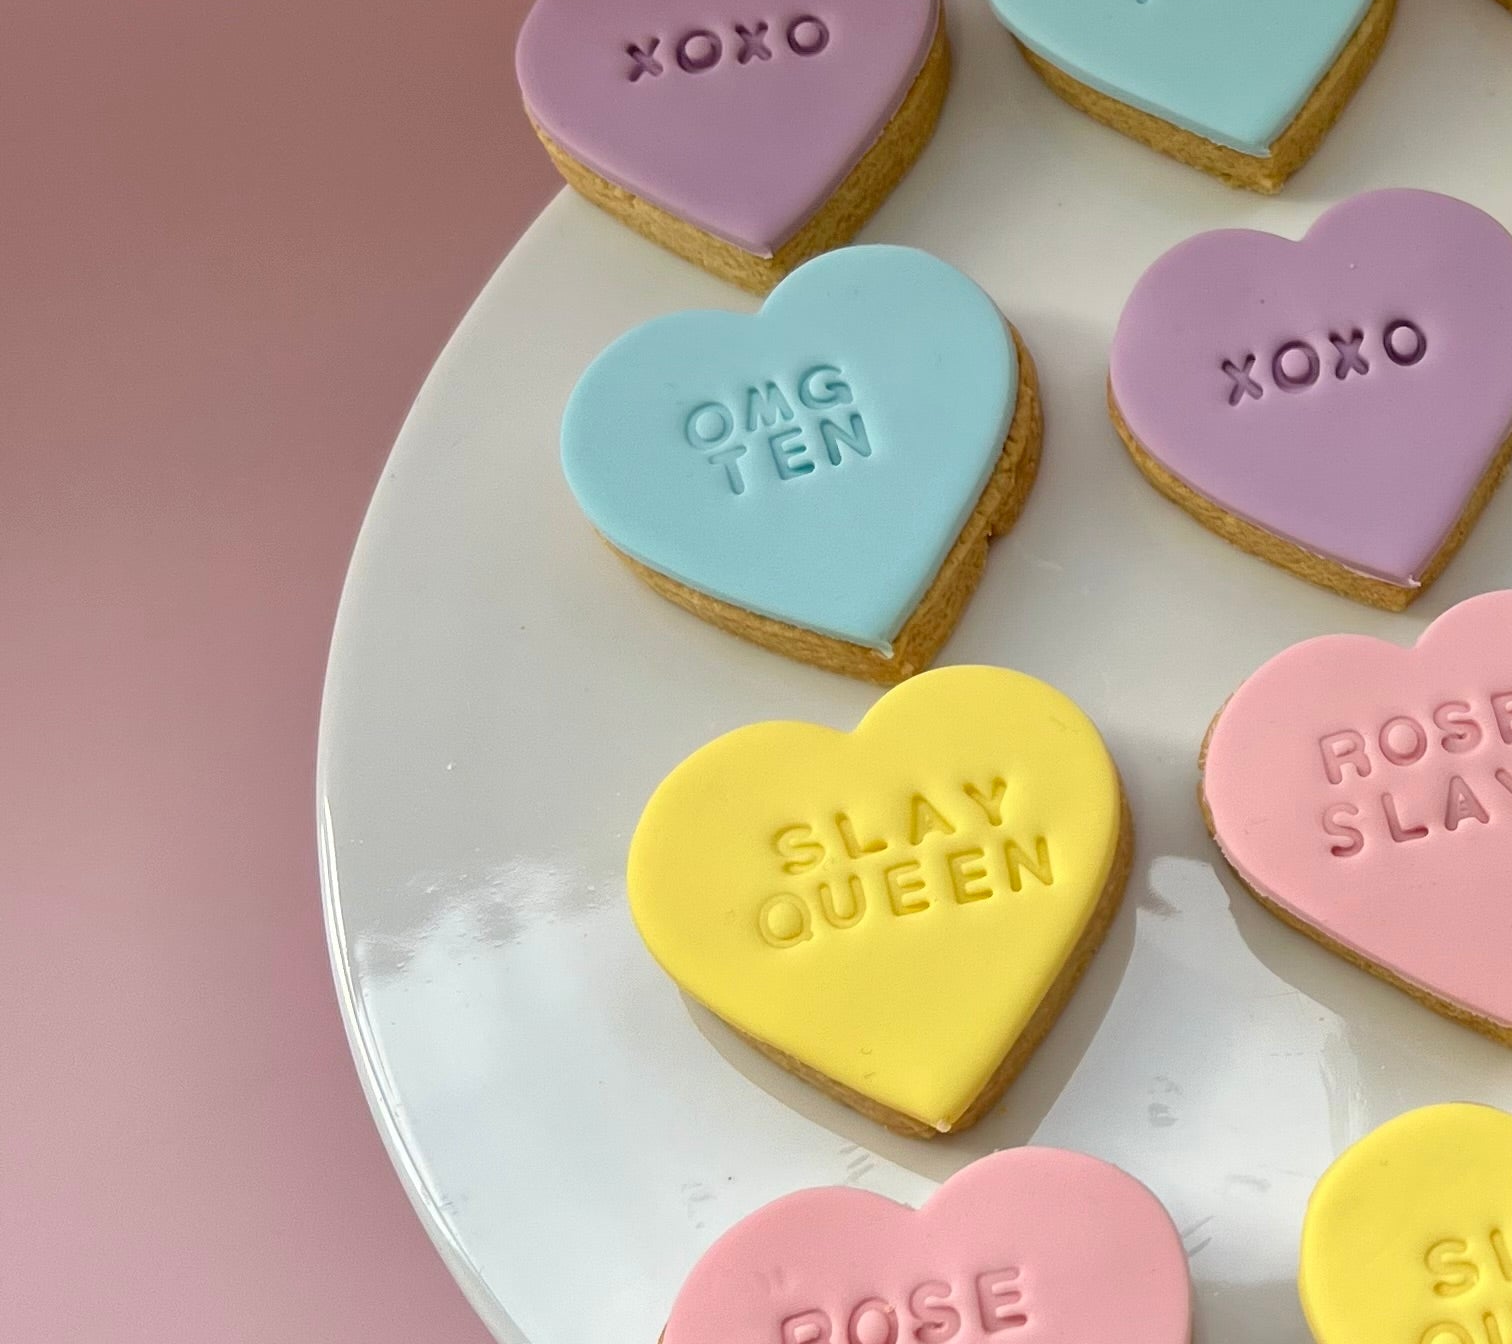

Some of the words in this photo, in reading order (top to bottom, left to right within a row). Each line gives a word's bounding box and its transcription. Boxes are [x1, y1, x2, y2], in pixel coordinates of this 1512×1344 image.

[624, 13, 831, 83] XOXO
[684, 362, 854, 449] OMG
[1221, 317, 1427, 407] XOXO
[706, 410, 874, 497] TEN
[774, 778, 1009, 875] SLAY
[758, 834, 1057, 949] QUEEN
